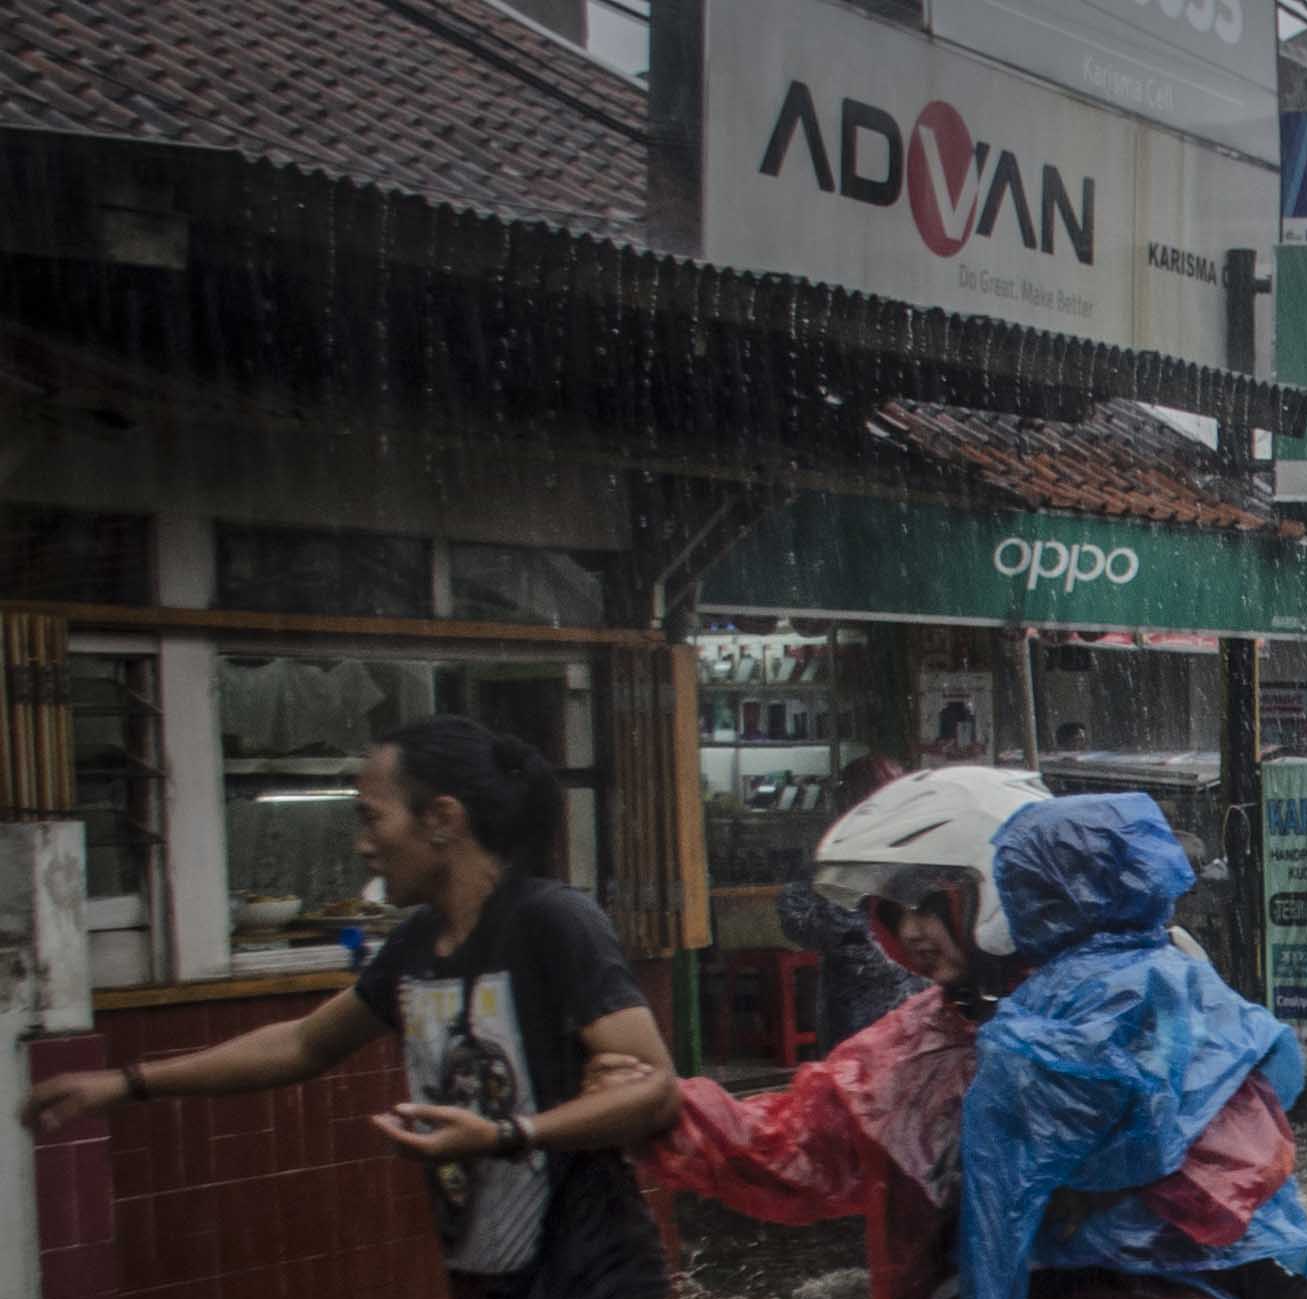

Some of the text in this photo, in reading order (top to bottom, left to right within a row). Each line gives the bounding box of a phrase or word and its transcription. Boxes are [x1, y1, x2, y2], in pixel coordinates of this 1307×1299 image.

[759, 80, 1094, 266] ADVAN
[1148, 241, 1217, 286] KARISMA
[994, 536, 1139, 593] oppo
